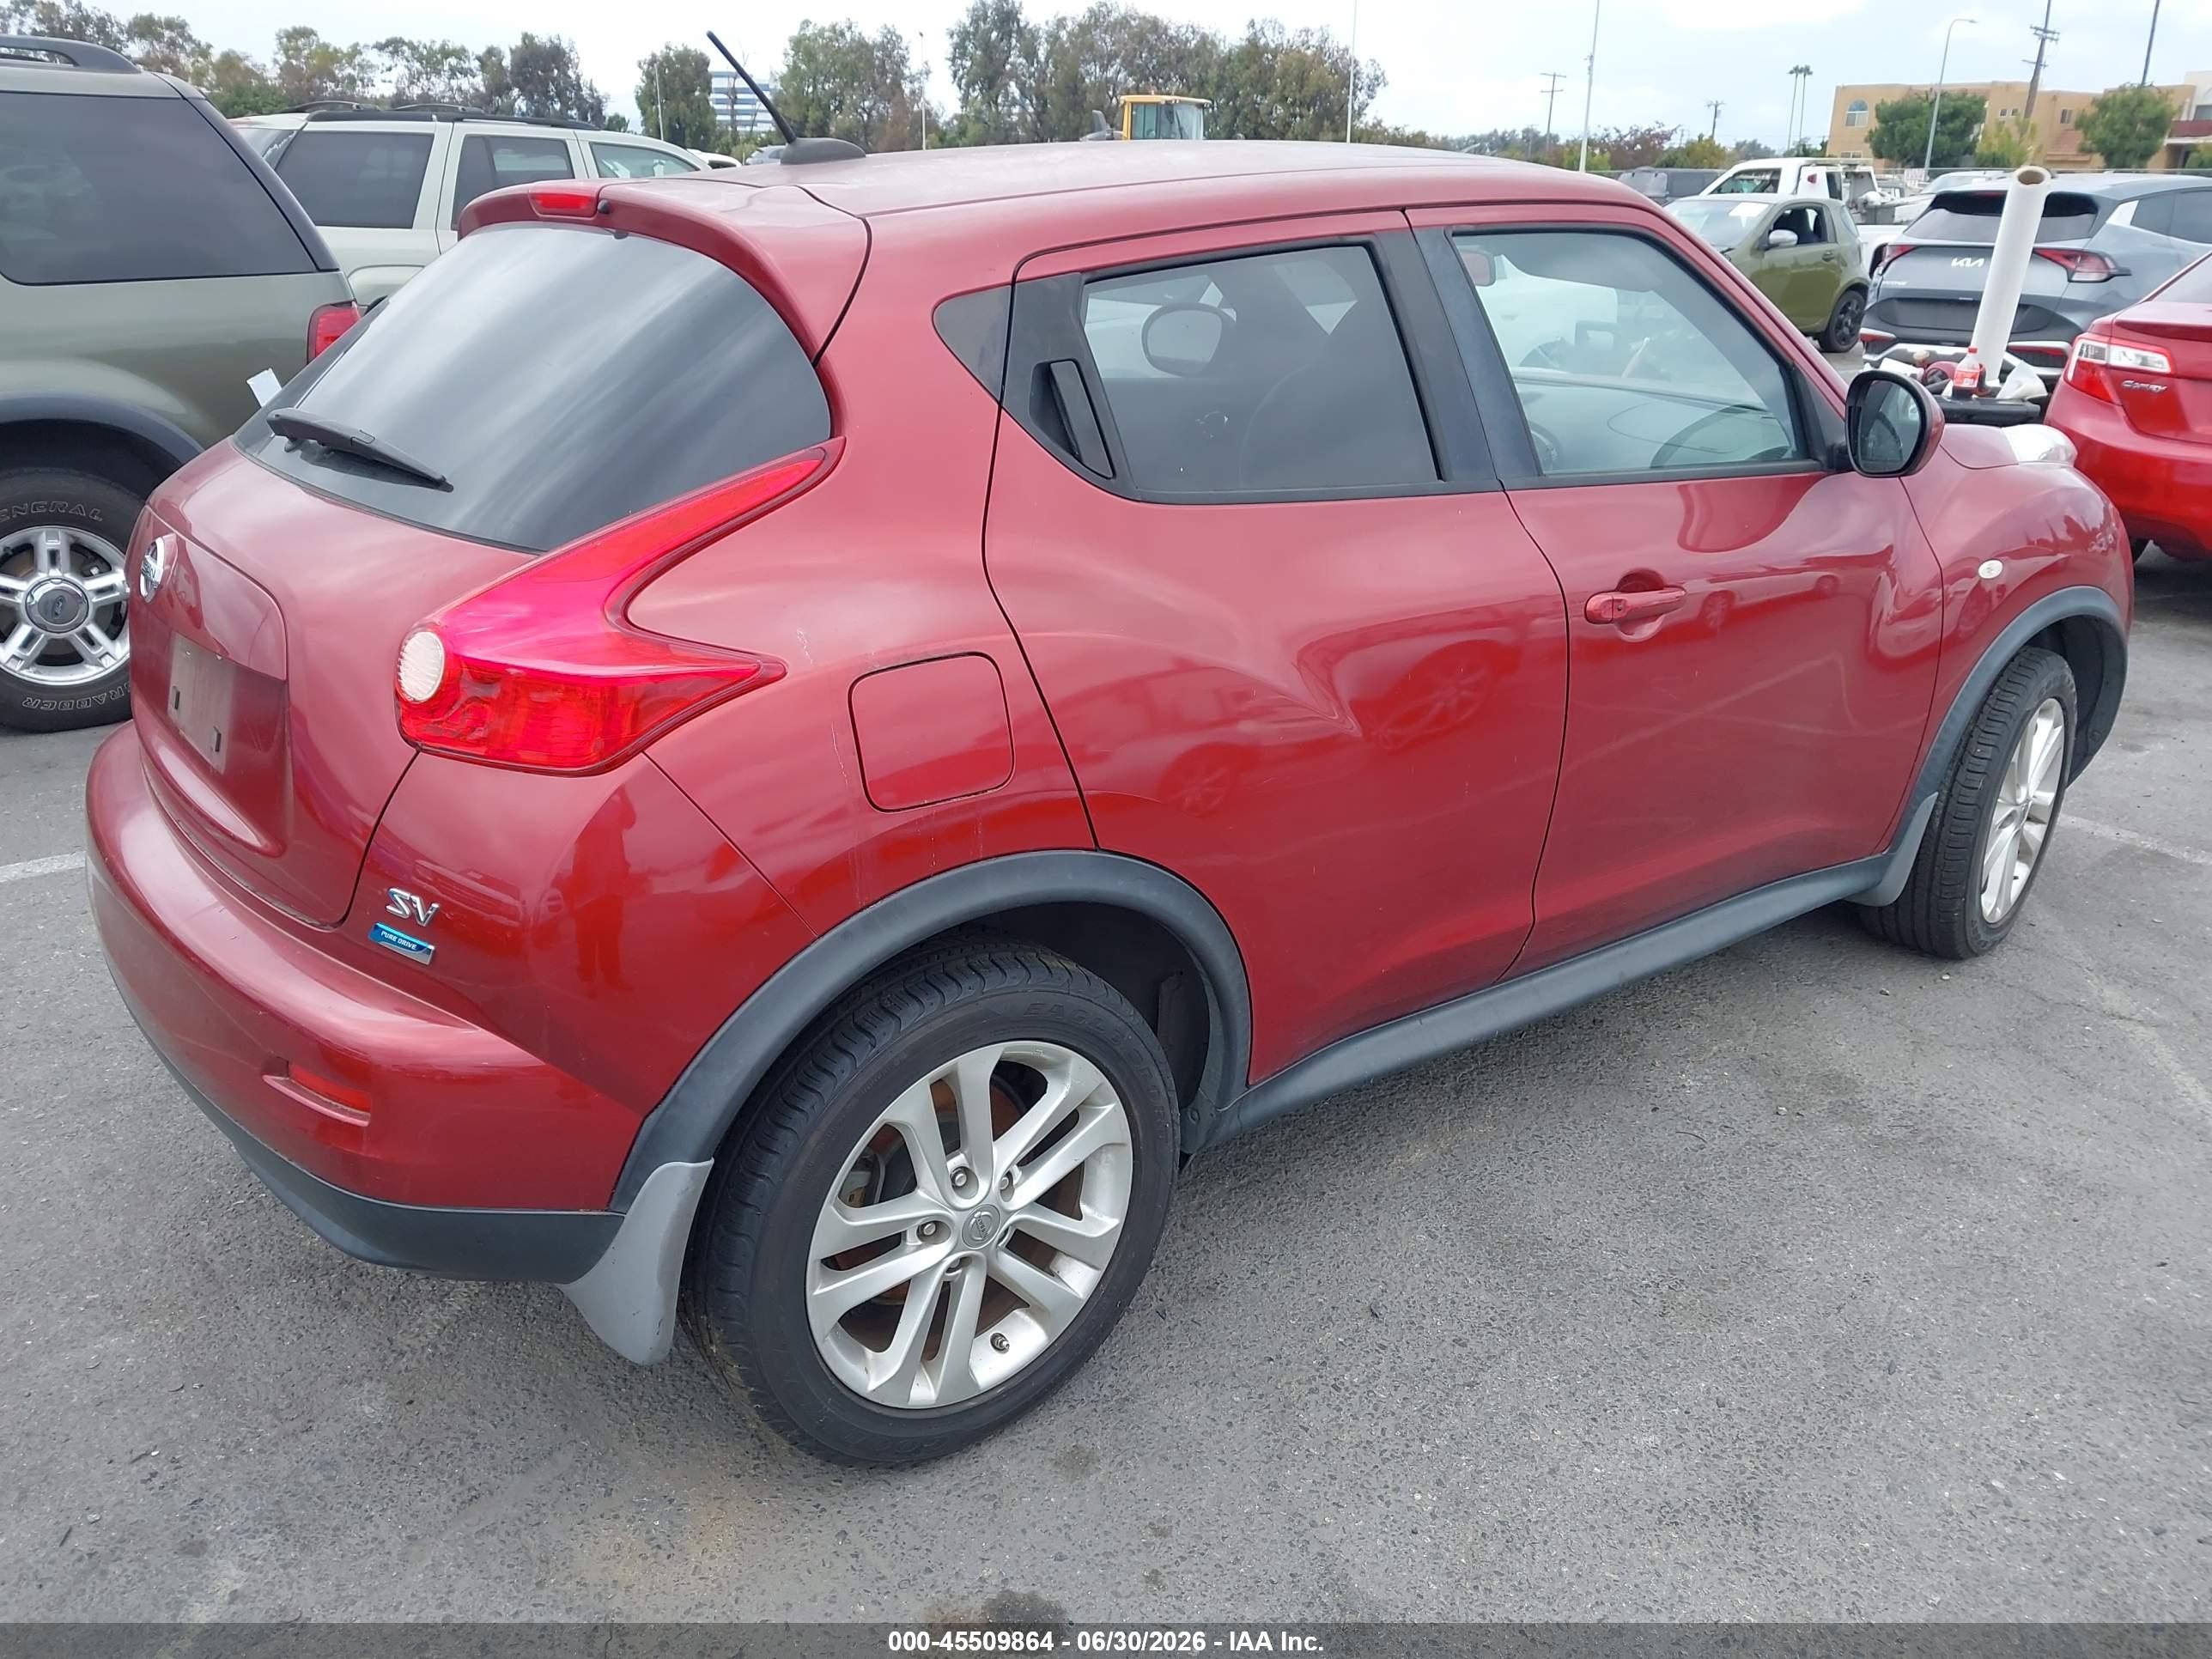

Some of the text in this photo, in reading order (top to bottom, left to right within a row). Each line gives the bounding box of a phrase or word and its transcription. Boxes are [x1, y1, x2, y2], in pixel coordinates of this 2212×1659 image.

[386, 888, 440, 927] SV
[380, 930, 417, 951] PURE DRIVE
